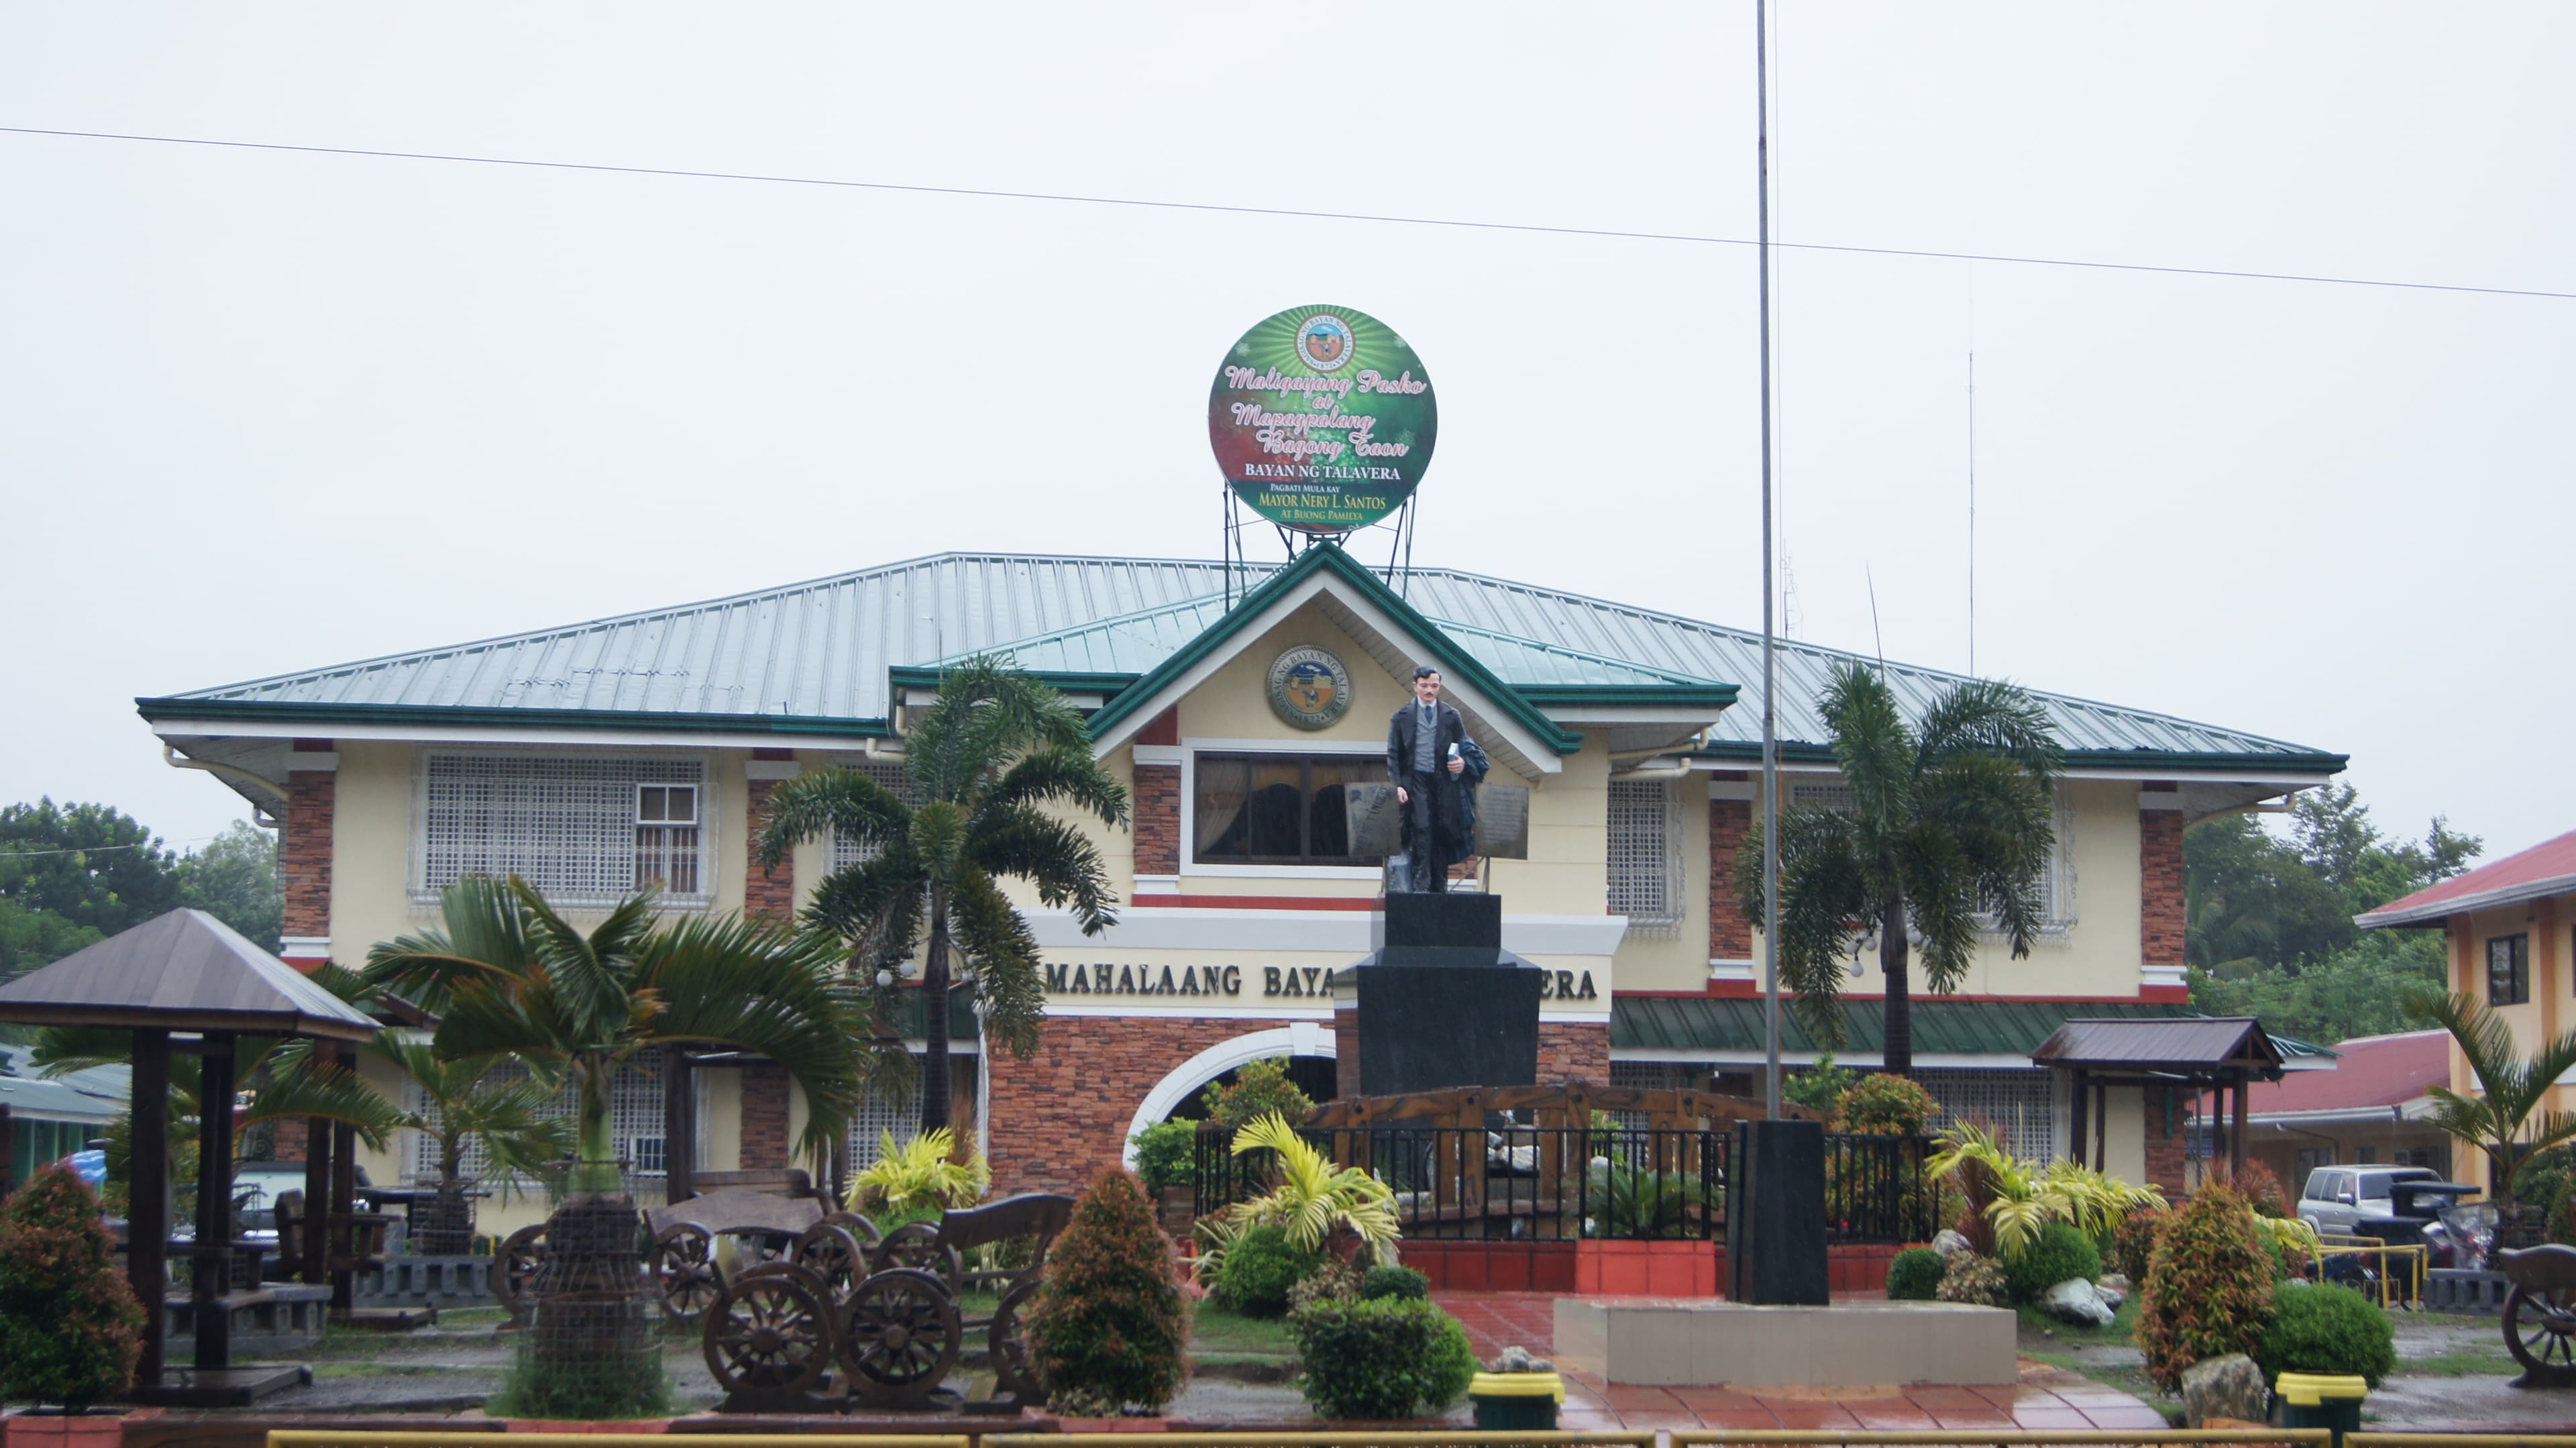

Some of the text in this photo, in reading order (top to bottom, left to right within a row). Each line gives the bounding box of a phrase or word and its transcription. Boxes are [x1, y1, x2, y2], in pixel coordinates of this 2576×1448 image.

[1225, 366, 1427, 399] Maligayang Pasko
[1312, 394, 1334, 409] at
[1231, 402, 1376, 435] Mapagpalang
[1256, 429, 1409, 462] Bagong Taon
[1245, 463, 1401, 480] BAYAN NG TALAVERA
[1259, 493, 1386, 509] MAYOR NERY L. SANTOS
[1277, 661, 1290, 676] NG
[1289, 652, 1323, 664] BAYAN
[1043, 964, 1598, 999] MAHALAANG BAYA ERA
